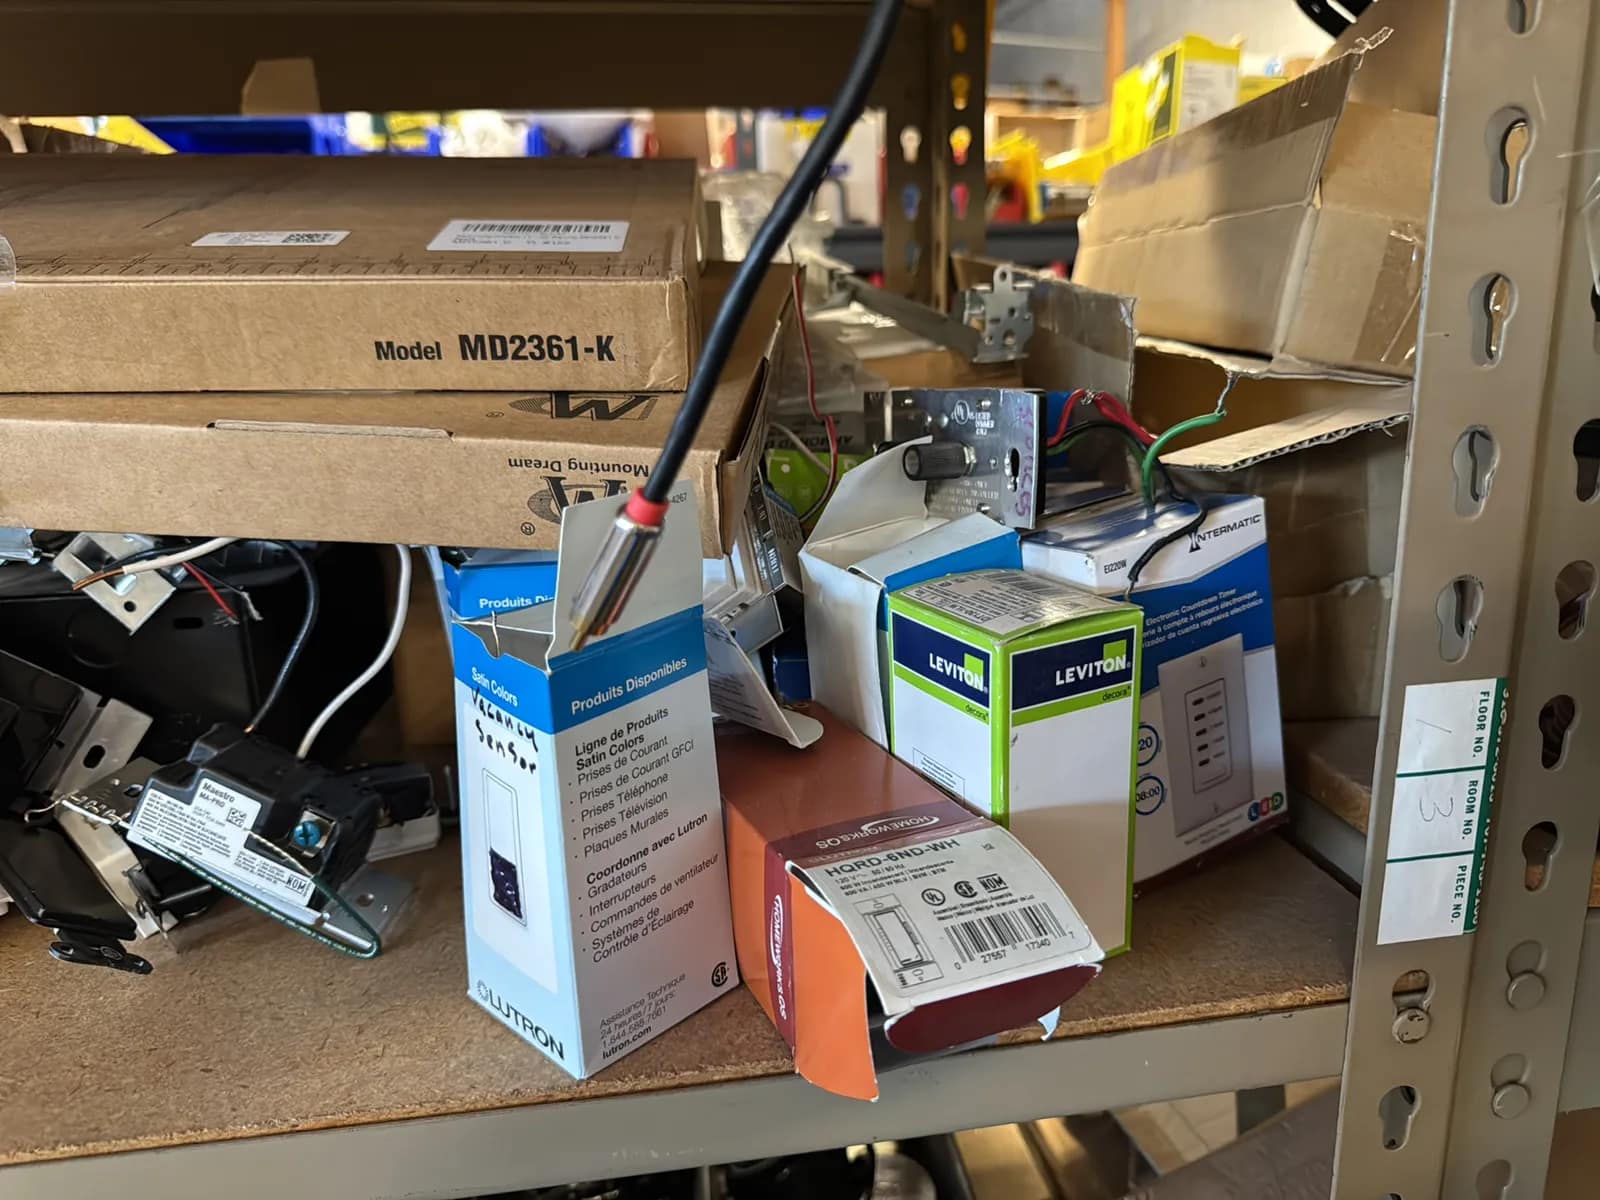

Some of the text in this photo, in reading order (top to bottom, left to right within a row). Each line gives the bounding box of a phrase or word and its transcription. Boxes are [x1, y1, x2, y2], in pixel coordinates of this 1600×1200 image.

[374, 334, 616, 361] Model MD2361-K
[508, 457, 649, 477] Mounting Dream
[1104, 559, 1128, 574] EI220W
[479, 596, 533, 609] Produits
[1146, 609, 1180, 626] Electronic
[472, 667, 518, 707] Satin Colors
[571, 657, 687, 716] Produits Disponibles
[929, 653, 984, 692] LEVITON
[1055, 654, 1126, 687] LEVITON
[965, 704, 987, 721] decora
[1102, 685, 1128, 702] decora
[575, 708, 669, 758] Ligne de Produits
[1472, 690, 1490, 758] FLOOR NO.
[576, 734, 645, 771] Satin Colors
[578, 735, 668, 786] Prises de Courant
[579, 739, 694, 804] Prises de Courant GFCI
[199, 792, 226, 807] MA-PRO
[202, 783, 236, 803] Maestro
[581, 772, 669, 822] Prises Téléphone
[1461, 780, 1479, 840] ROOM NO.
[582, 791, 668, 840] Prises Télévision
[584, 808, 669, 858] Plaques Murales
[815, 815, 931, 849] HOMEWORKS QS
[586, 813, 708, 885] Coordonne avec Lutron
[824, 839, 961, 877] HQRD-6ND-WH
[587, 861, 648, 899] Gradateurs
[589, 873, 657, 916] Interrupteurs
[590, 853, 719, 933] Commandes de ventilateur
[979, 874, 1008, 892] NOM
[1450, 865, 1467, 924] PIECE NO.
[592, 907, 660, 950] Systèmes de
[593, 933, 639, 963] Contrôle
[980, 951, 1007, 964] 27557
[600, 973, 686, 1027] Assistance Technique
[489, 988, 565, 1061] LUTRON
[602, 1026, 652, 1060] lutron.com
